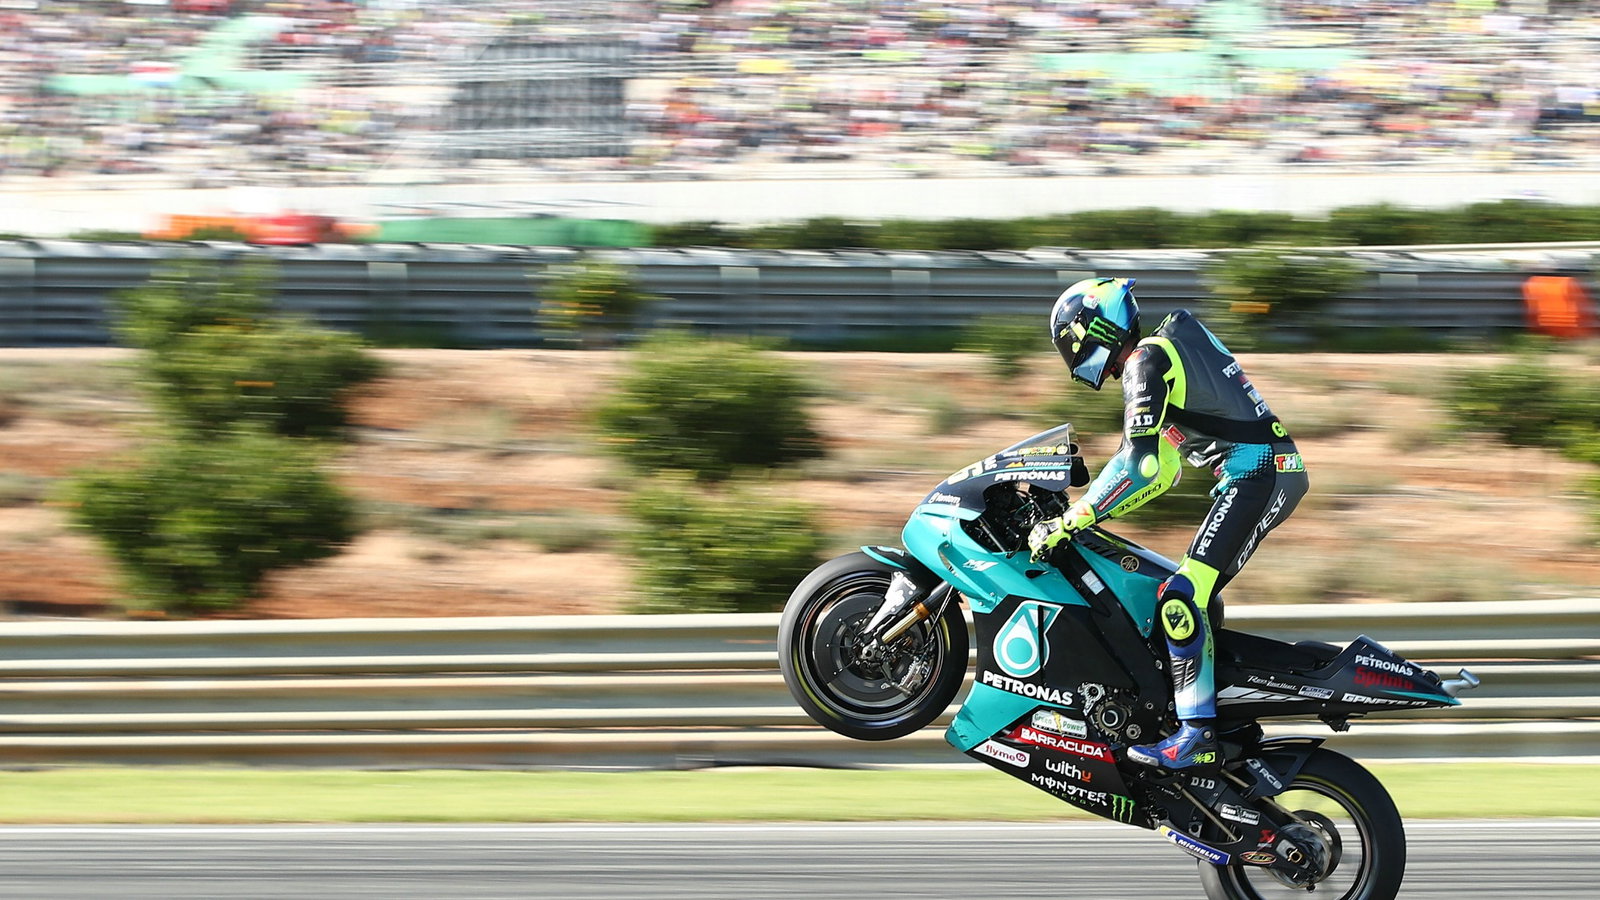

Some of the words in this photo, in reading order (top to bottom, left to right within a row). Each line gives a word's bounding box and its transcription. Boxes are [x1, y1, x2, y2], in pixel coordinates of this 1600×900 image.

[994, 471, 1066, 482] PETRONAS
[1196, 487, 1238, 557] PETRONAS
[1355, 654, 1414, 676] PETRONAS
[983, 671, 1073, 705] PETRONAS
[1020, 728, 1104, 758] BARRACUDA
[1031, 772, 1108, 807] MONSTER
[1178, 839, 1221, 861] MICHELIN
